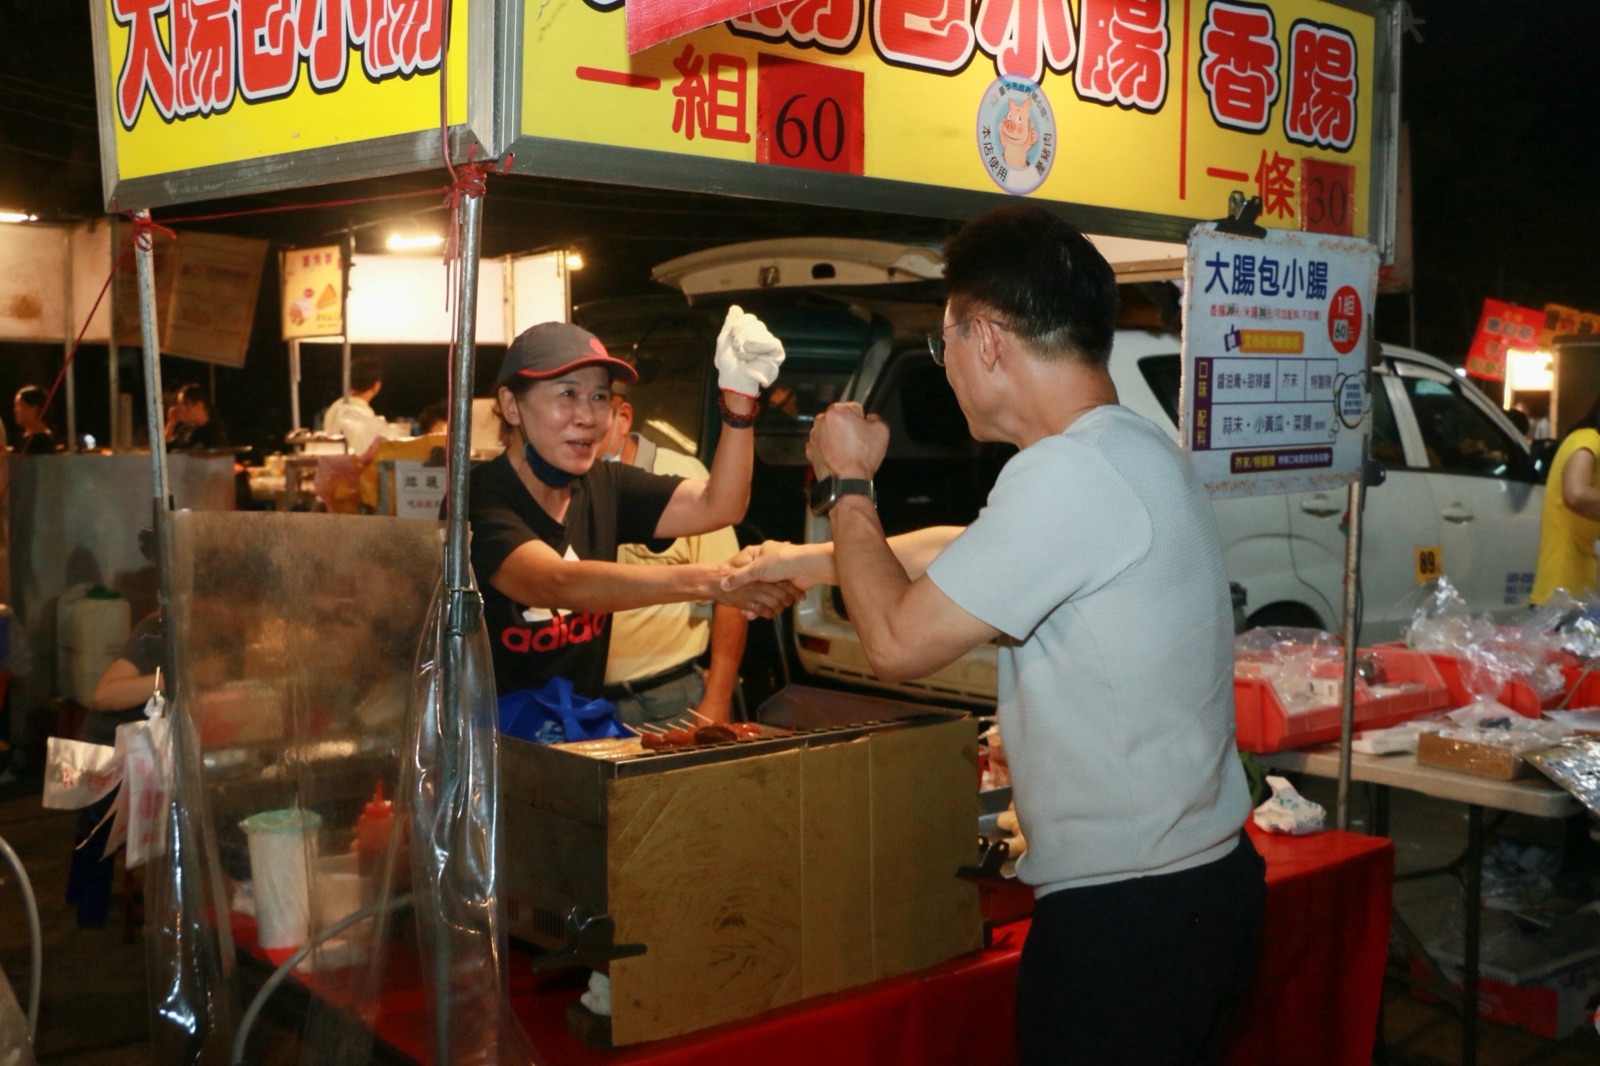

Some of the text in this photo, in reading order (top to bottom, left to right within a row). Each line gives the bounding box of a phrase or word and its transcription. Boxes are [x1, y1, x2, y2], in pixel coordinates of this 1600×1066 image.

[1201, 0, 1358, 150] 香腸
[576, 44, 845, 162] 一組 60
[982, 125, 1009, 183] 本店使用
[1206, 149, 1346, 227] 一條 30
[1204, 251, 1328, 300] 大腸包小腸
[1338, 294, 1355, 316] 1組
[1199, 362, 1209, 398] 口味
[1282, 373, 1298, 388] 芥末
[1419, 551, 1435, 575] 89
